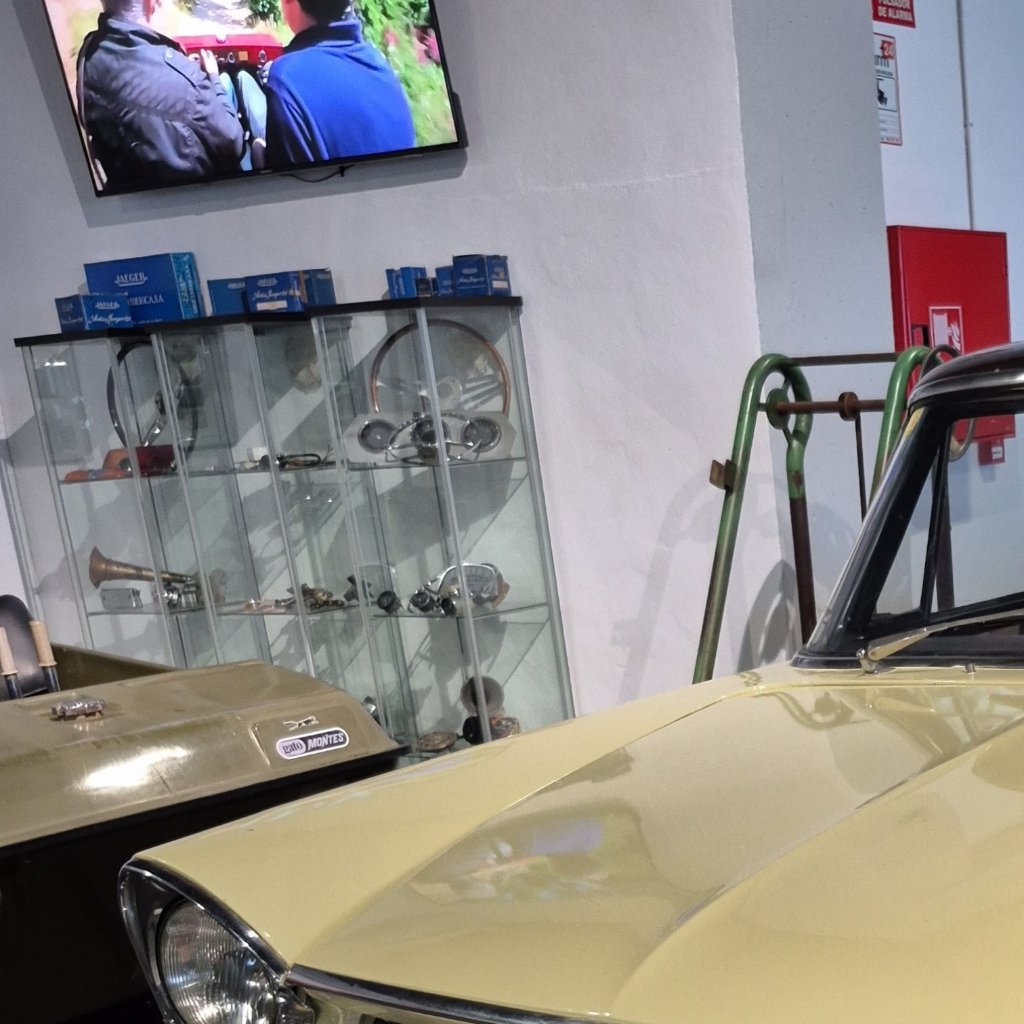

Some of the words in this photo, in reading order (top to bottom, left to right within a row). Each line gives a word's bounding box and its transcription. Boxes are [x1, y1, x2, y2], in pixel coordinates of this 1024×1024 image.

[878, 6, 888, 17] DE
[888, 8, 913, 22] ALARMA
[114, 272, 148, 287] JAEGER
[95, 301, 121, 310] JAEGER
[282, 741, 303, 754] gato
[307, 732, 344, 751] MONTES
